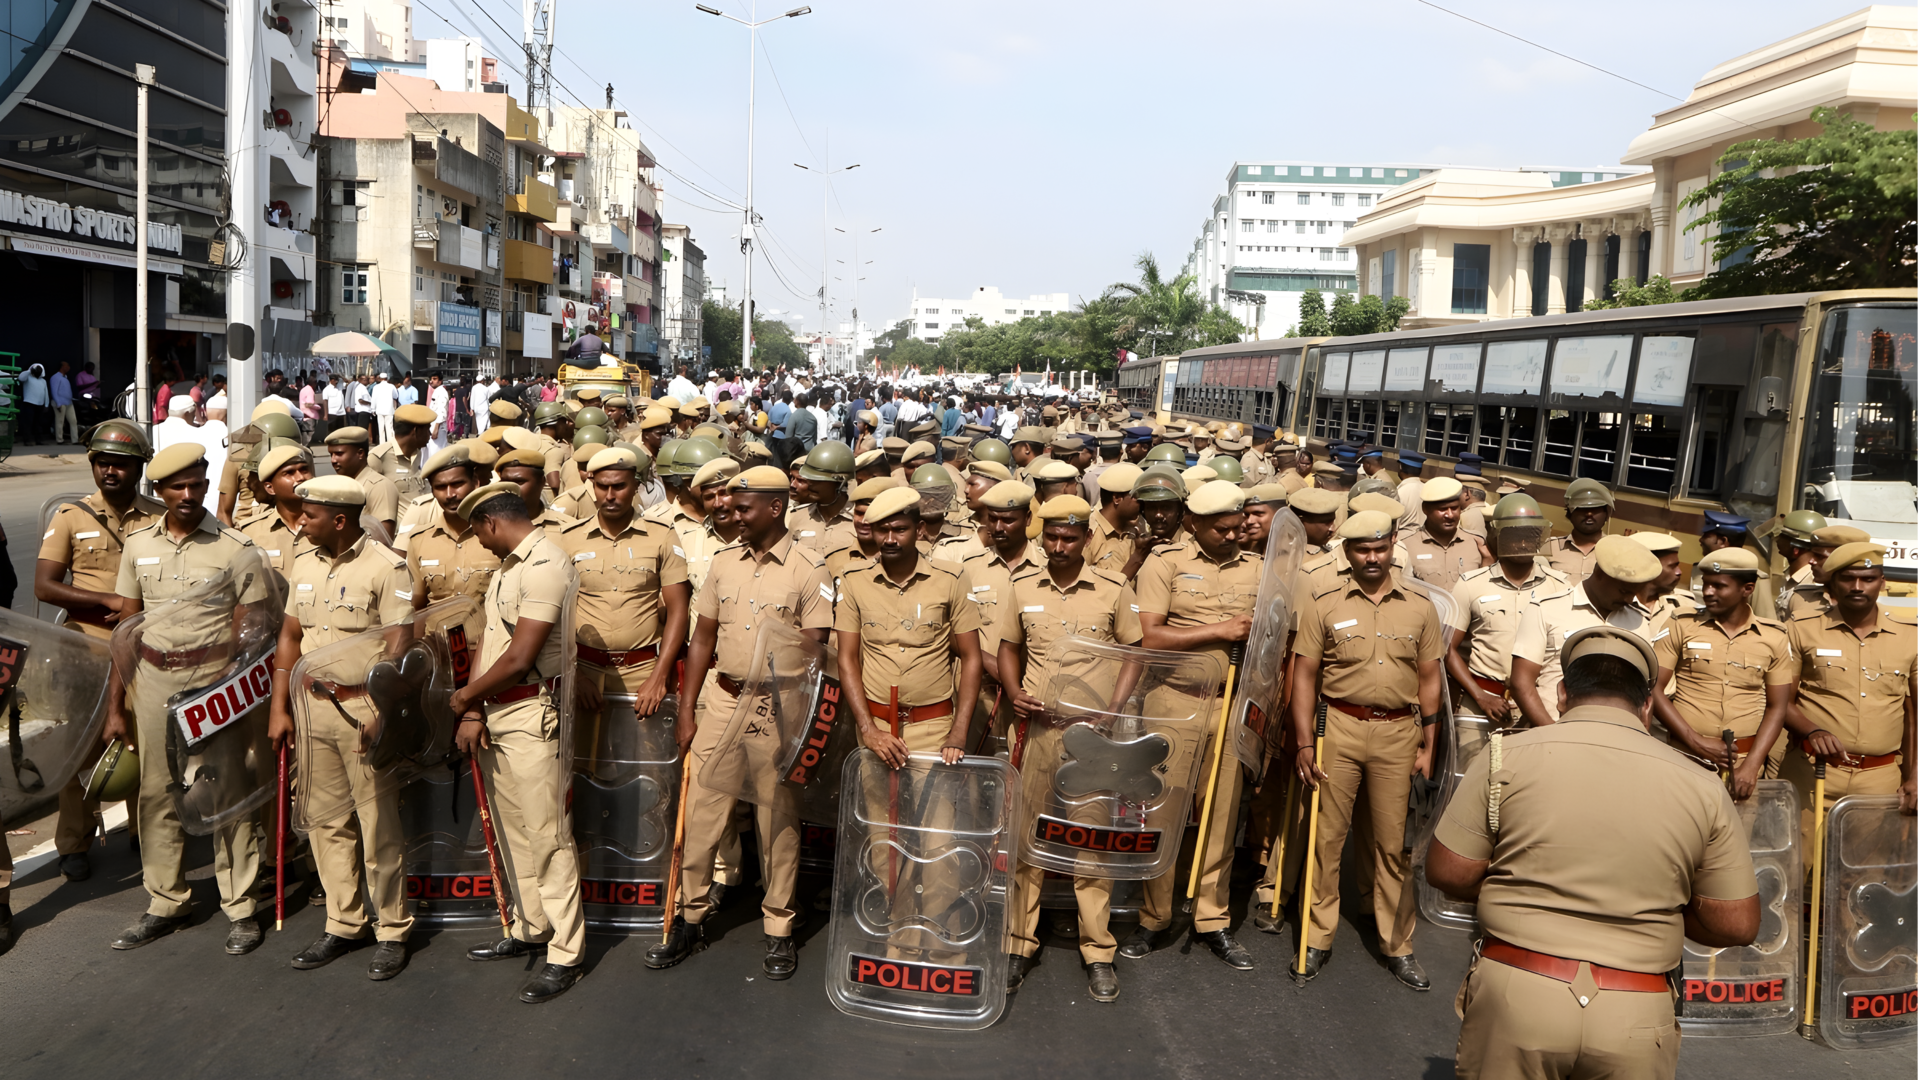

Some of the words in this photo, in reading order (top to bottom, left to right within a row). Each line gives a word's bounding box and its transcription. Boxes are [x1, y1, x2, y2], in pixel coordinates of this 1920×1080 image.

[73, 206, 136, 245] SPORTS
[790, 683, 840, 784] POLICE
[1045, 822, 1154, 851] POLICE
[407, 876, 492, 898] OLICE
[857, 959, 973, 994] POLICE
[1685, 979, 1783, 1003] POLICE
[1852, 990, 1919, 1018] POLIC
